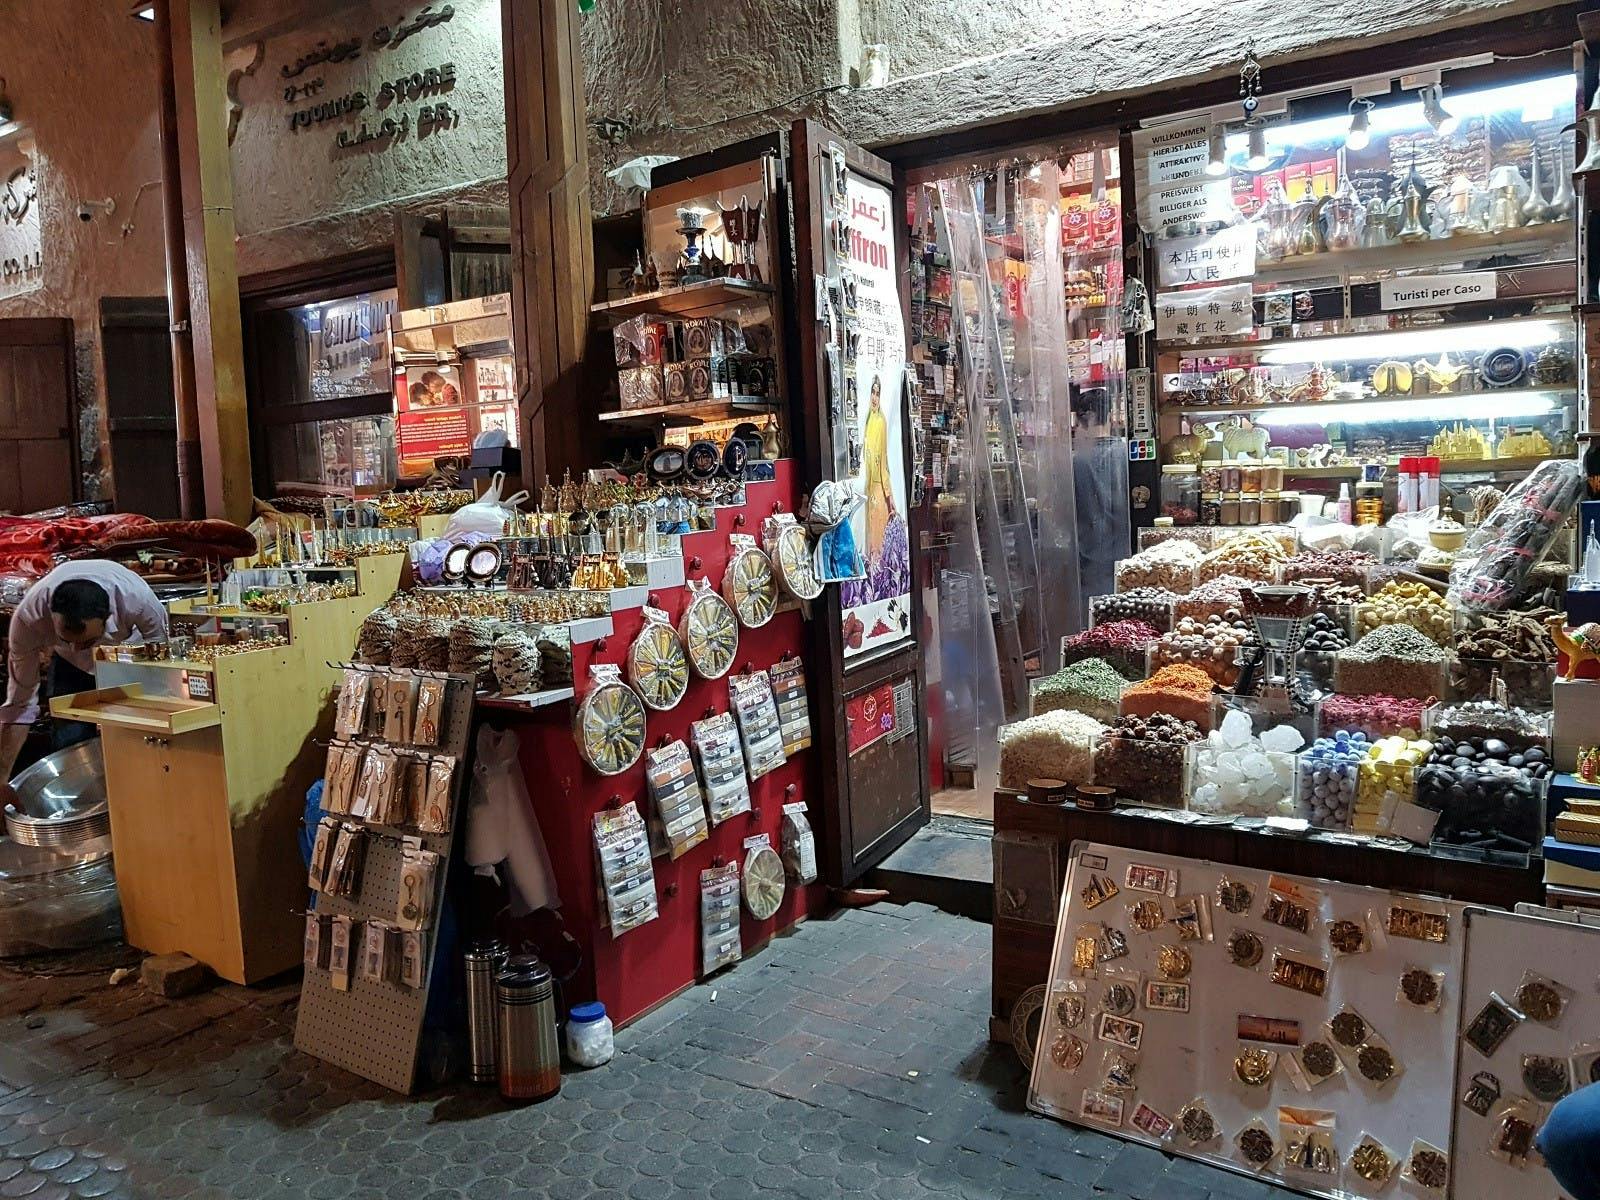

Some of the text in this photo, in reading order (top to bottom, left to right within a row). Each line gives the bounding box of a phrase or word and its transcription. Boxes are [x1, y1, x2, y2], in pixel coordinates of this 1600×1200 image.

[377, 62, 456, 106] STORE
[1152, 126, 1206, 144] WILLKOMMEN
[1185, 140, 1207, 150] ALLES
[1161, 185, 1203, 199] PREISWERT
[1159, 198, 1207, 213] BILLIGER ALS
[1162, 211, 1206, 226] ANDERSWO
[1393, 285, 1481, 302] Turisti per Caso
[1164, 301, 1243, 318] 伊朗特级
[1177, 320, 1227, 335] 藏红花
[1130, 444, 1154, 456] JCB
